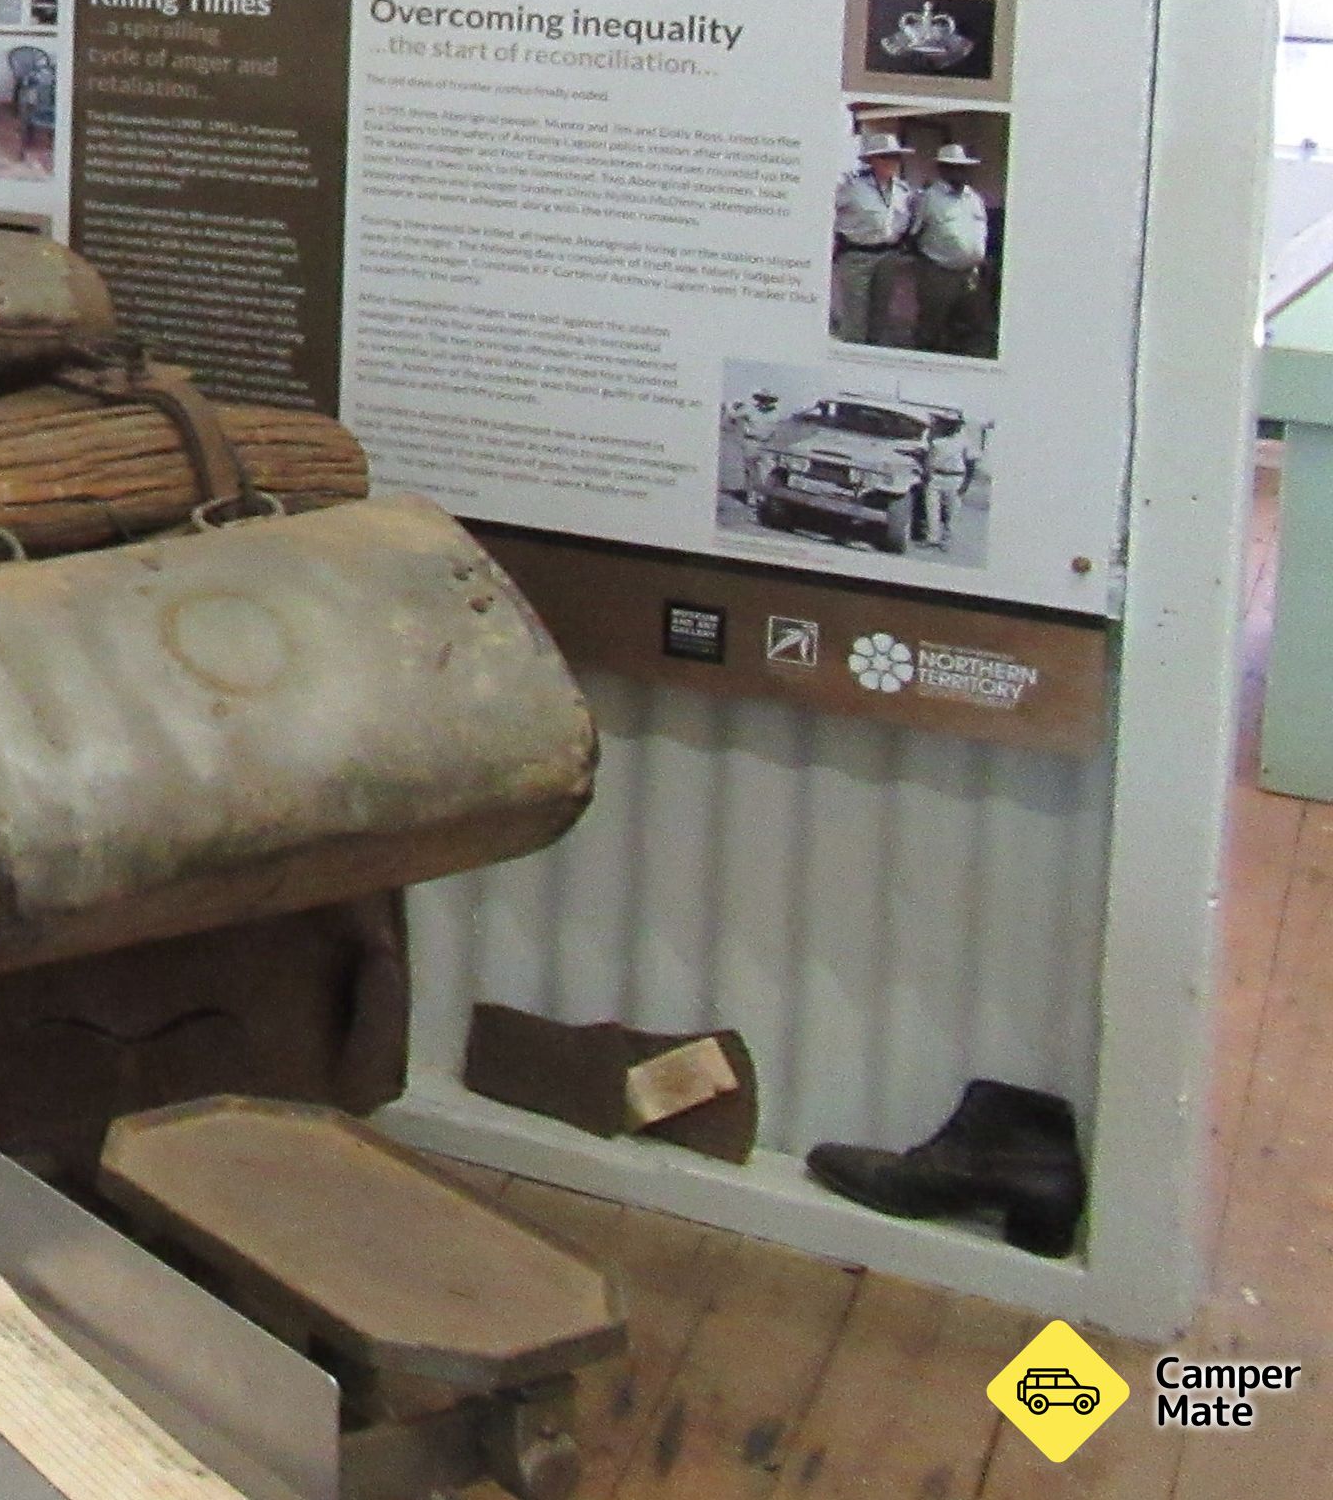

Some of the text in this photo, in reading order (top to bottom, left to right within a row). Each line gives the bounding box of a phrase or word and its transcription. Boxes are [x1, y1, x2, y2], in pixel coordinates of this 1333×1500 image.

[123, 19, 221, 47] spiralling
[572, 7, 744, 51] inequality
[87, 47, 278, 77] cycle of anger and
[432, 40, 488, 62] start
[494, 42, 518, 64] of
[918, 649, 1039, 686] NORTHERN
[919, 667, 1024, 700] TERRITORY
